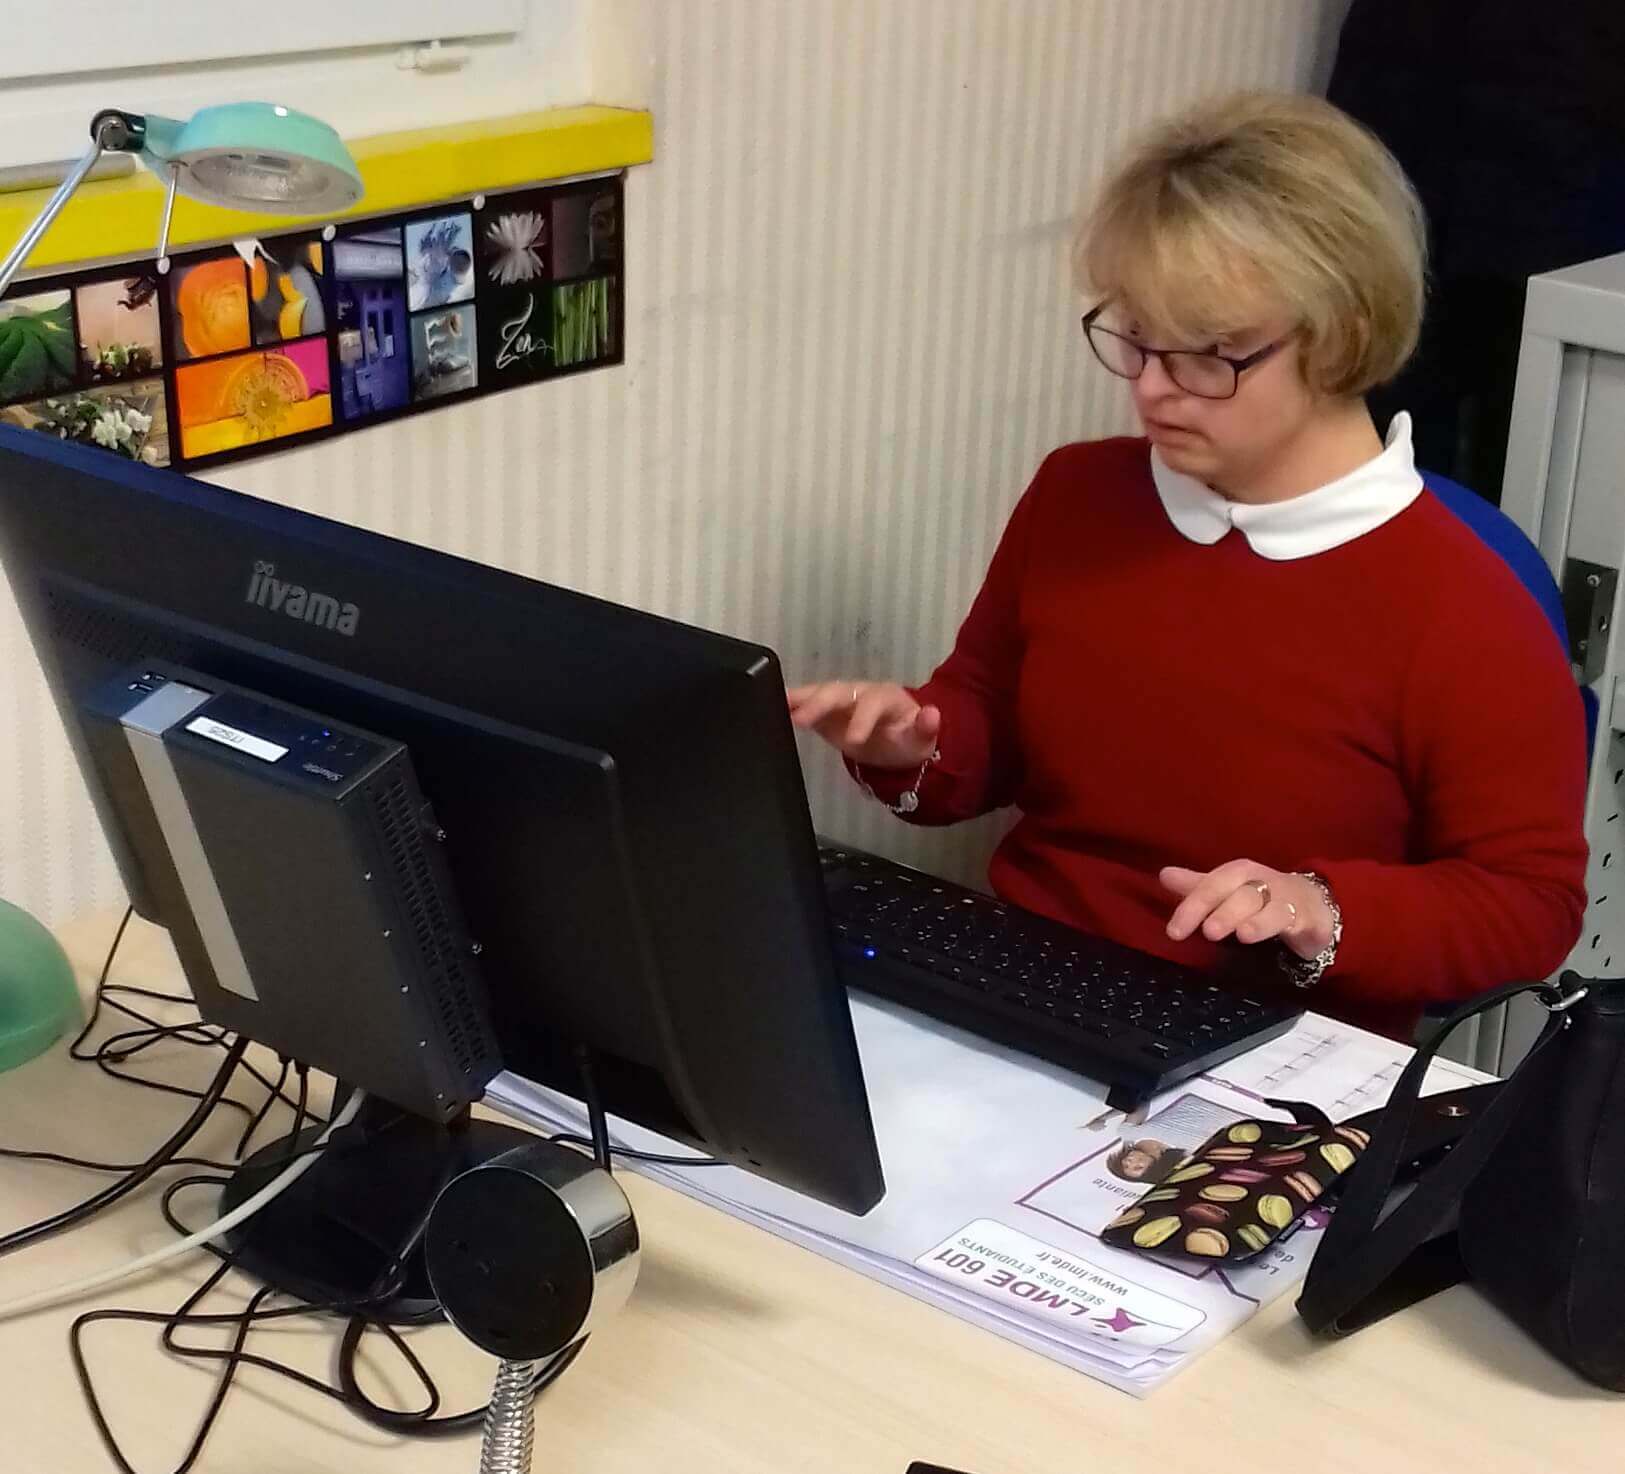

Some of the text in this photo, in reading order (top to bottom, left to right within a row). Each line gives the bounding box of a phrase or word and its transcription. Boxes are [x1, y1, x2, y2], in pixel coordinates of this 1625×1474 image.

[245, 560, 361, 637] iiyama
[957, 1236, 1037, 1278] ÉTUDIANTS
[1035, 1250, 1129, 1298] www.lmde.fr
[1038, 1271, 1067, 1289] DES
[932, 1246, 1090, 1317] LMDE 601
